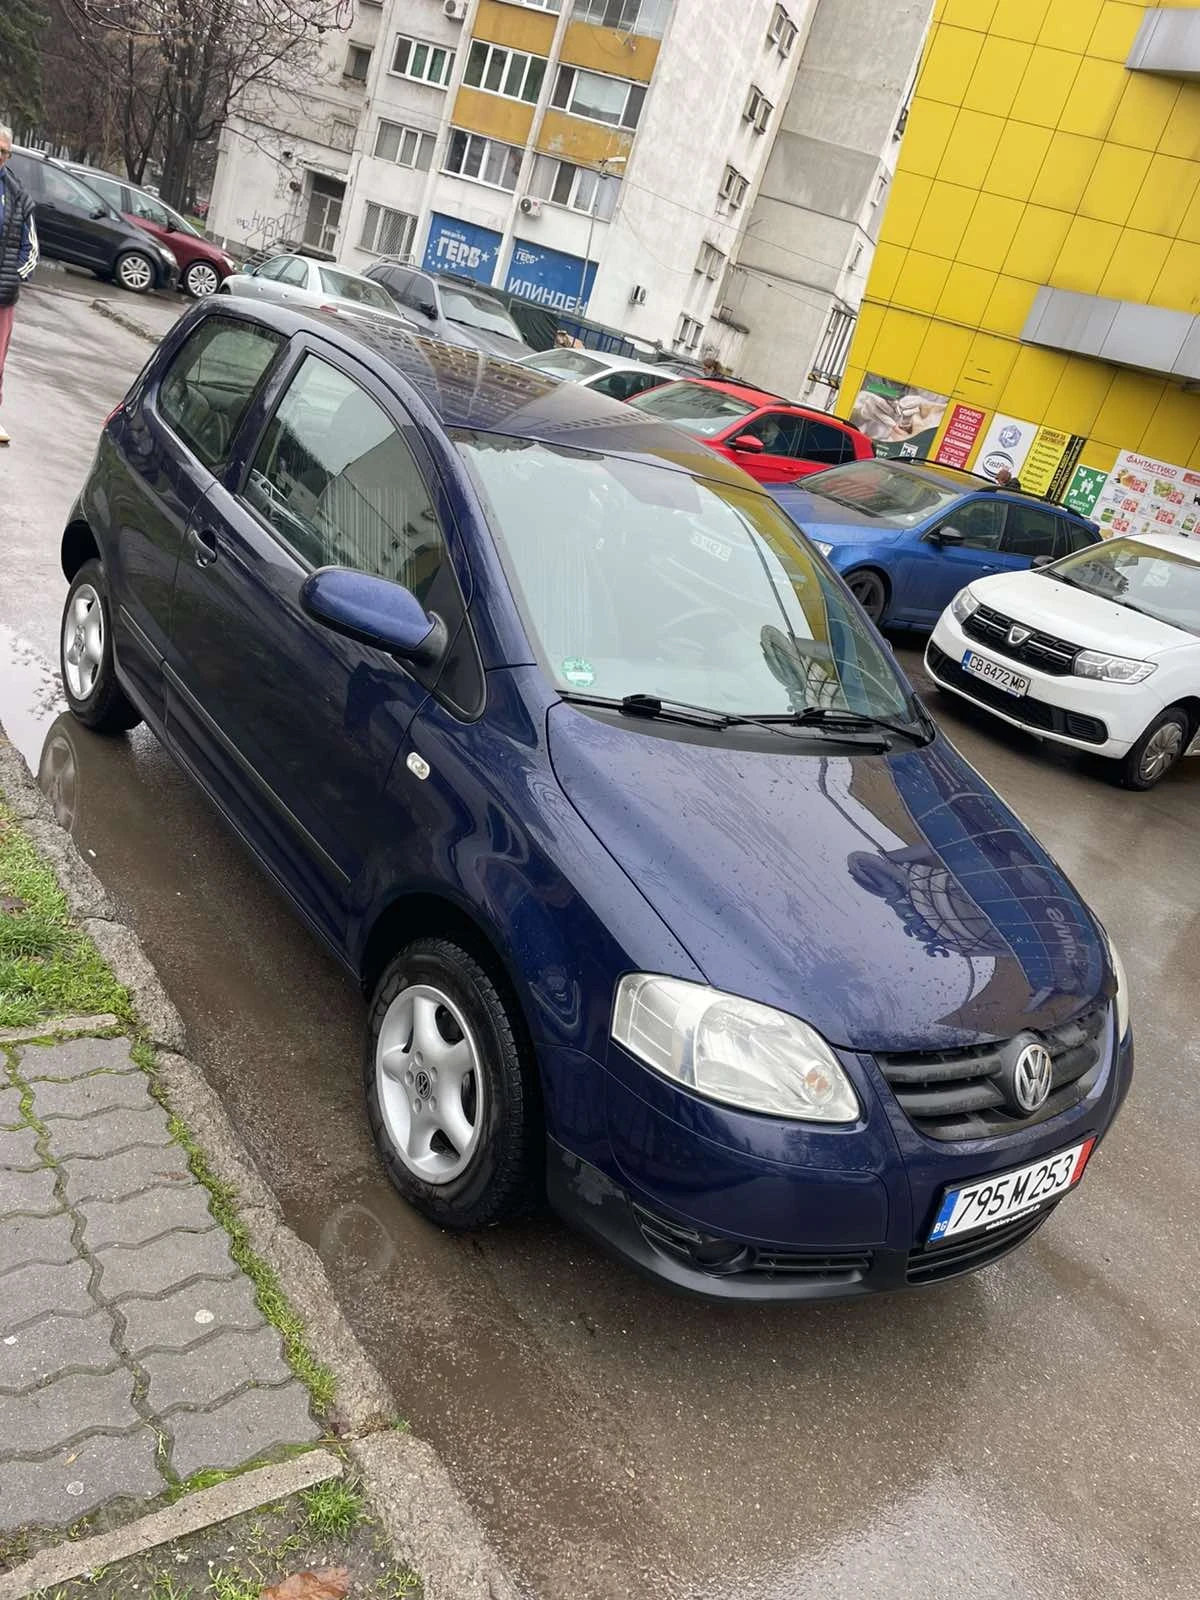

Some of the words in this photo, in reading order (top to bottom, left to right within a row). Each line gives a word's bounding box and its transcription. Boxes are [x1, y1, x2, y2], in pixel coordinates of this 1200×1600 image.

[436, 236, 482, 268] ГЕРБ
[515, 251, 536, 264] ГЕРБ
[985, 457, 1011, 470] FastP
[1126, 454, 1178, 477] ФАНТАСТИКО
[969, 656, 984, 672] CB
[983, 663, 1011, 685] 8472
[1009, 676, 1026, 691] MP
[952, 1179, 1010, 1229] 795
[1007, 1171, 1032, 1210] M
[1028, 1153, 1075, 1201] 253
[932, 1220, 948, 1235] BG
